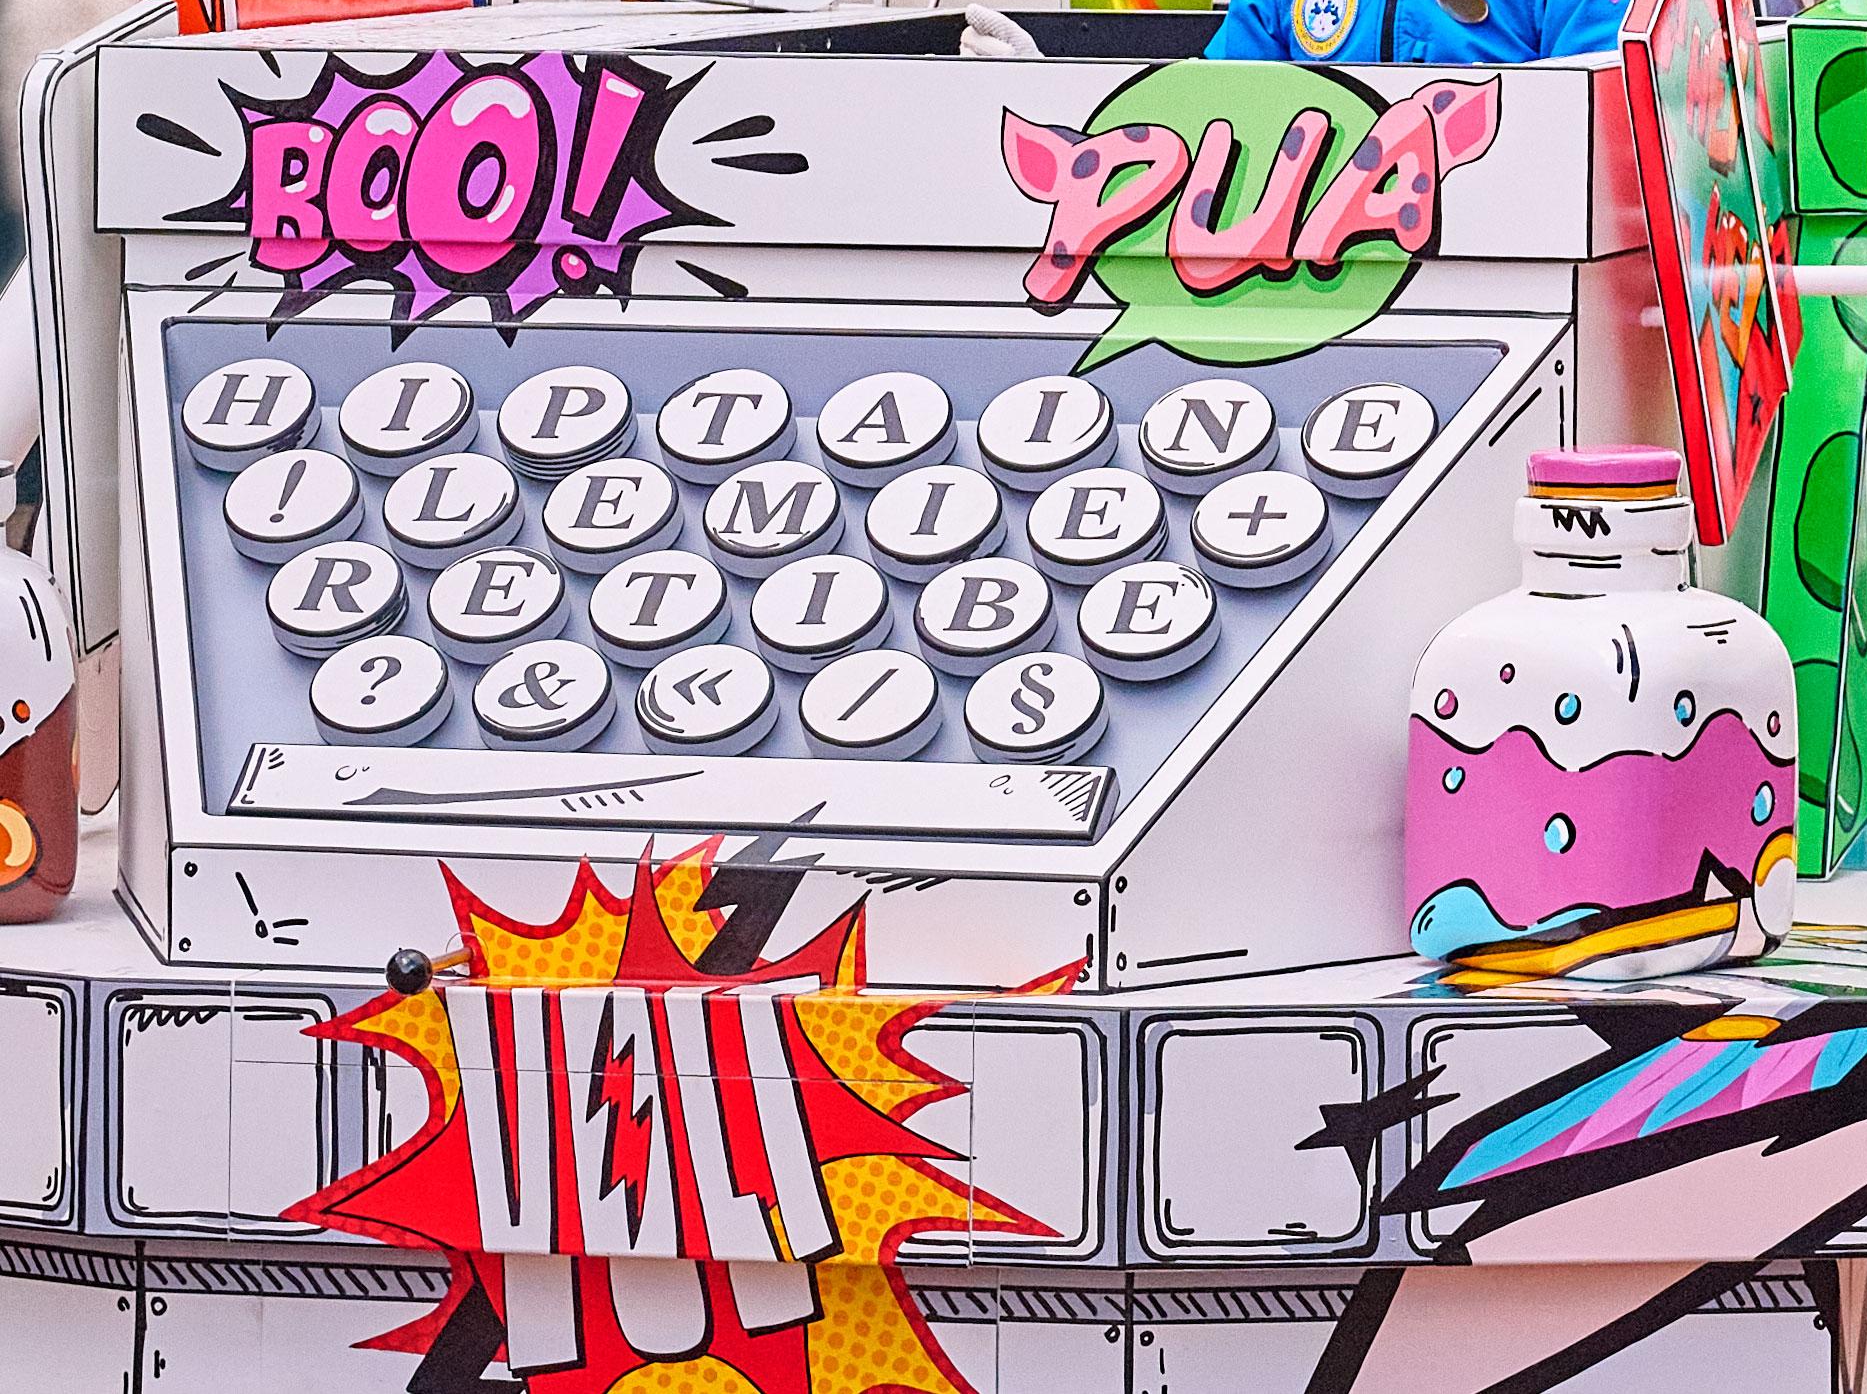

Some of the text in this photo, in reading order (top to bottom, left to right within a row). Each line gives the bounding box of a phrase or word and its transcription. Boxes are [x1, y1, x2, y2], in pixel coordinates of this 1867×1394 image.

[248, 62, 645, 282] BOO!
[1002, 74, 1503, 312] PUA
[203, 374, 1400, 453] H I P T A I N E
[412, 468, 475, 521] L
[569, 476, 642, 529] E
[719, 481, 821, 534] M
[910, 483, 955, 535] I
[1056, 487, 1126, 539] E
[294, 557, 1178, 634] R E T I B E
